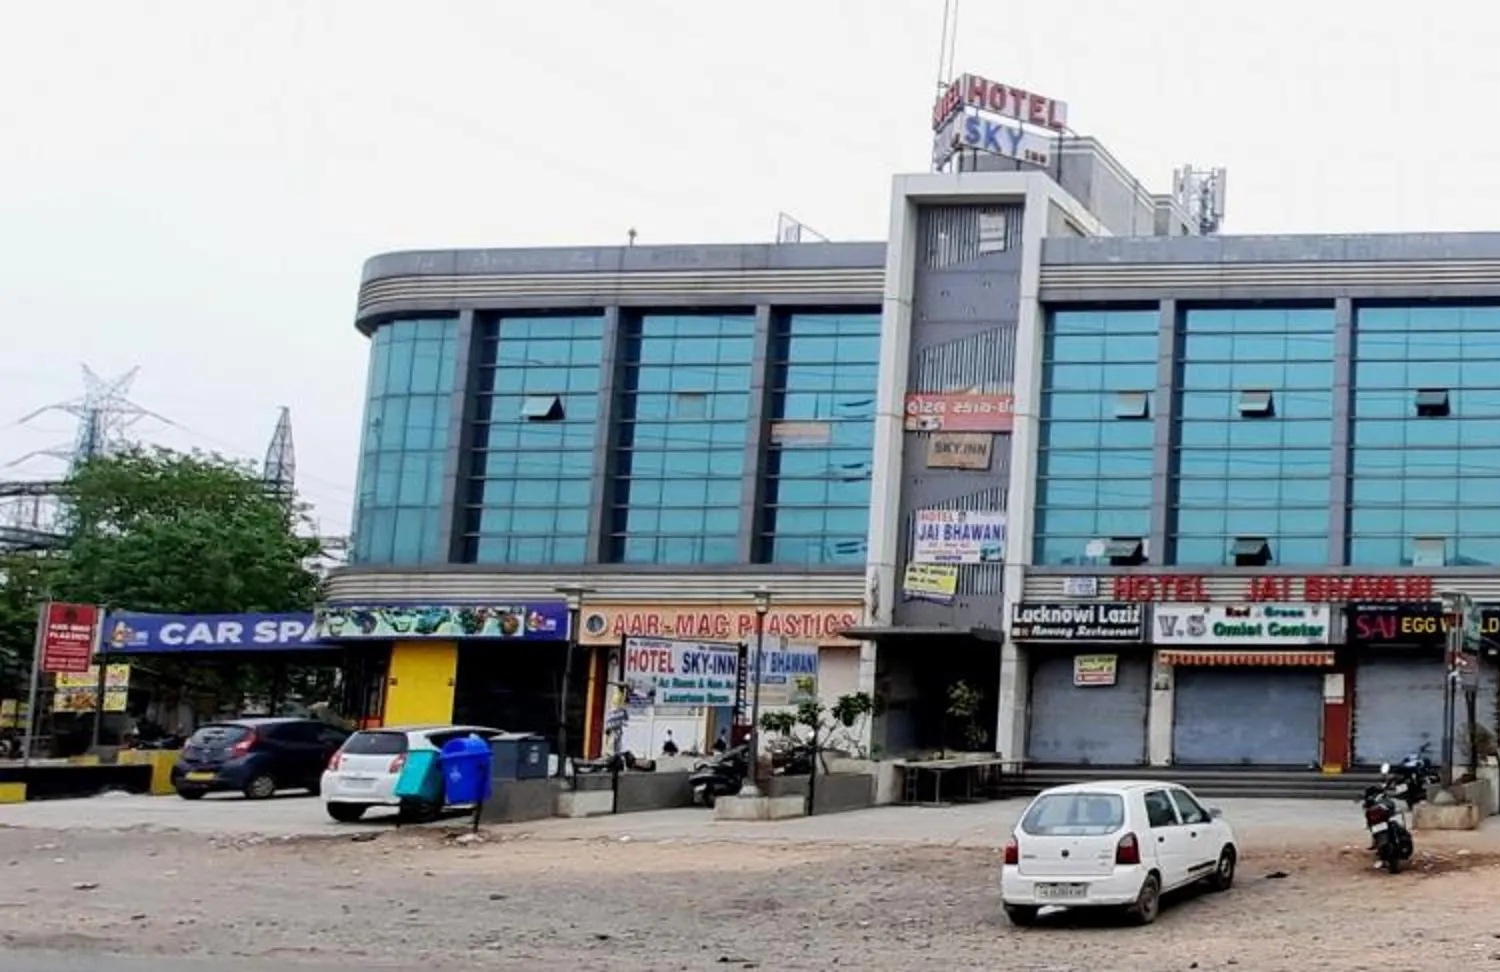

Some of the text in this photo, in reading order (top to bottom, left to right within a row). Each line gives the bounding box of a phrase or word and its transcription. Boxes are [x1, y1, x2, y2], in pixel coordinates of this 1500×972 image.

[966, 75, 1063, 130] HOTEL
[965, 116, 1024, 156] SKY
[943, 523, 1005, 541] BHAWANI
[1112, 576, 1211, 602] HOTEL
[159, 621, 243, 645] CAR
[738, 613, 858, 638] PASTICS
[1357, 615, 1397, 639] SAI
[1401, 617, 1436, 633] EGG
[626, 648, 736, 675] HOTEL SKY-INN
